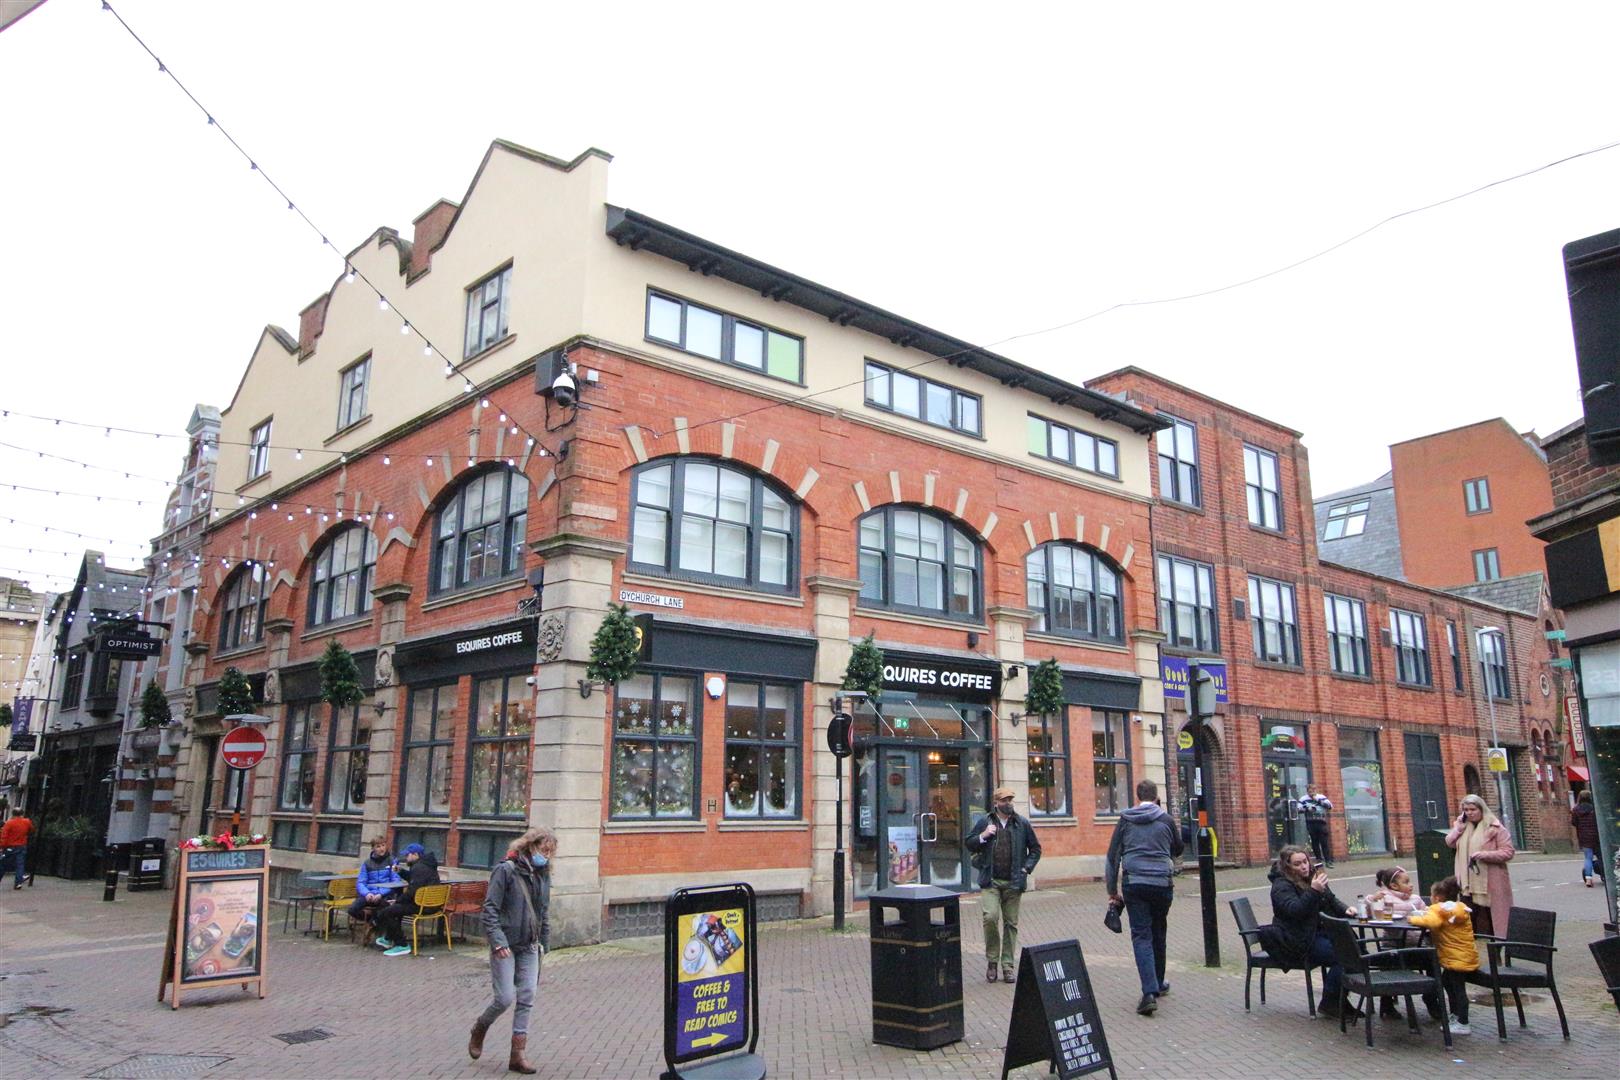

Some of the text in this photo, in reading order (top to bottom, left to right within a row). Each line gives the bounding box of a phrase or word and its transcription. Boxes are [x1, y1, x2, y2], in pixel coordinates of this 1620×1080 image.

[621, 591, 682, 608] DYCHURCH LANE
[108, 639, 155, 650] OPTIMIST
[456, 631, 522, 654] ESQUIRES COFFEE
[880, 665, 993, 690] QUIRES COFFEE
[707, 799, 717, 812] H
[693, 980, 731, 998] COFFEE &
[696, 996, 728, 1014] FREE TO
[685, 1010, 737, 1032] READ COMICS
